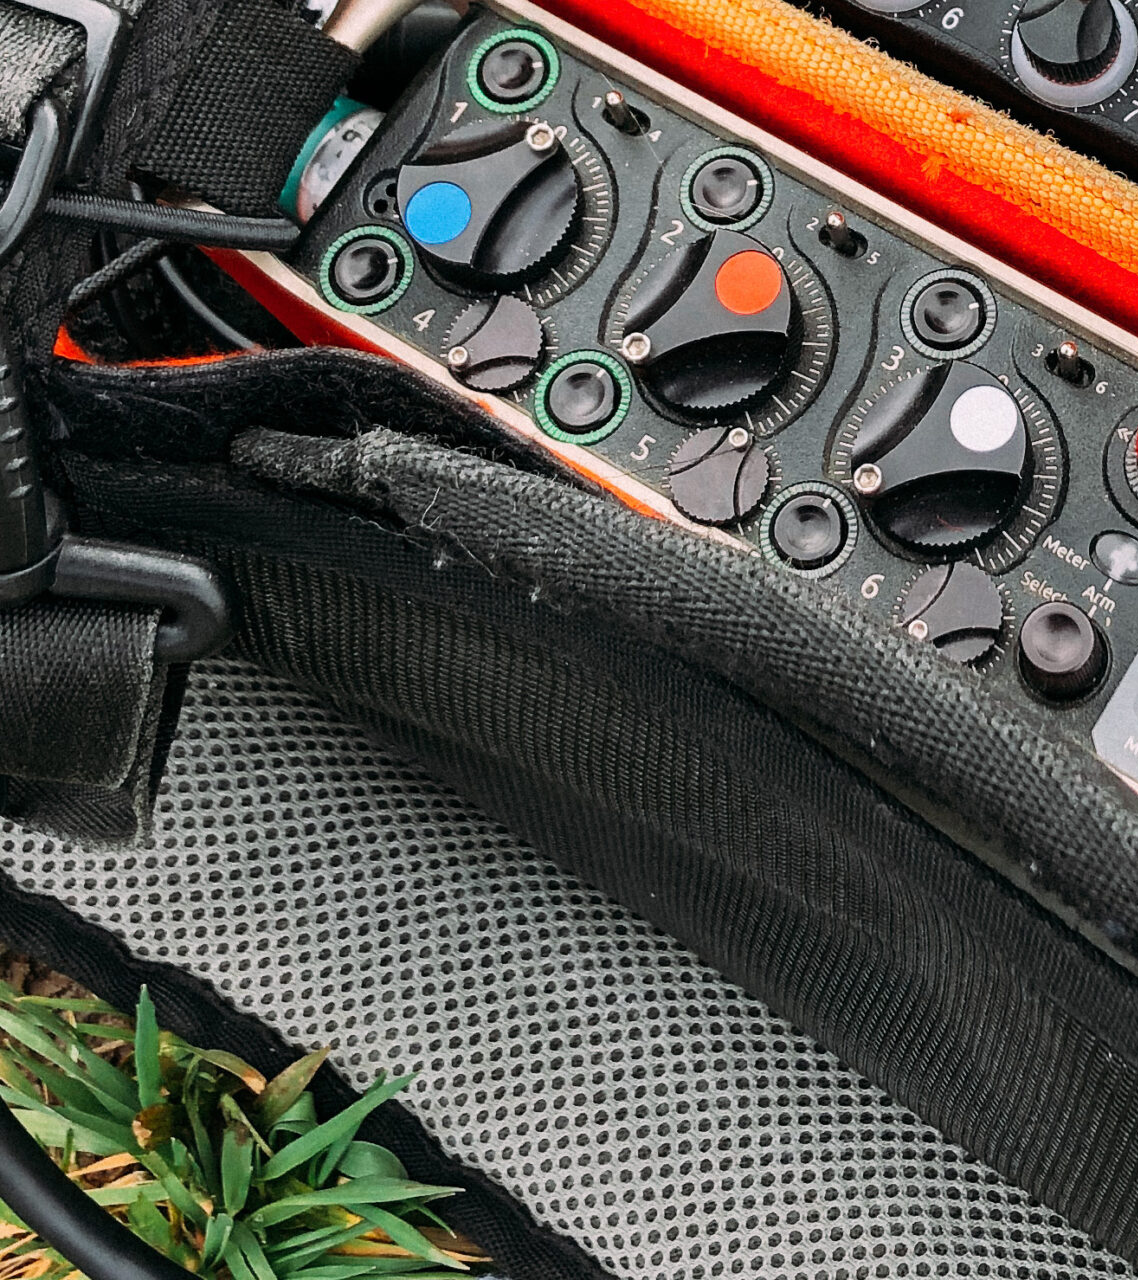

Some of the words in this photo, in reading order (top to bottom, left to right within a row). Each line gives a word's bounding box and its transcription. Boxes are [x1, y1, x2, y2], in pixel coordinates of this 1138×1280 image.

[941, 6, 965, 31] 6
[451, 101, 469, 123] 1
[592, 96, 602, 109] 1
[649, 130, 662, 142] 4
[661, 220, 685, 245] 2
[805, 218, 819, 231] 2
[867, 252, 878, 265] 5
[412, 308, 436, 332] 4
[882, 345, 906, 372] 3
[1031, 344, 1044, 357] 3
[1095, 381, 1108, 395] 6
[630, 434, 657, 461] 5
[1042, 535, 1090, 571] Meter
[860, 573, 886, 599] 6
[1082, 585, 1117, 613] Arm
